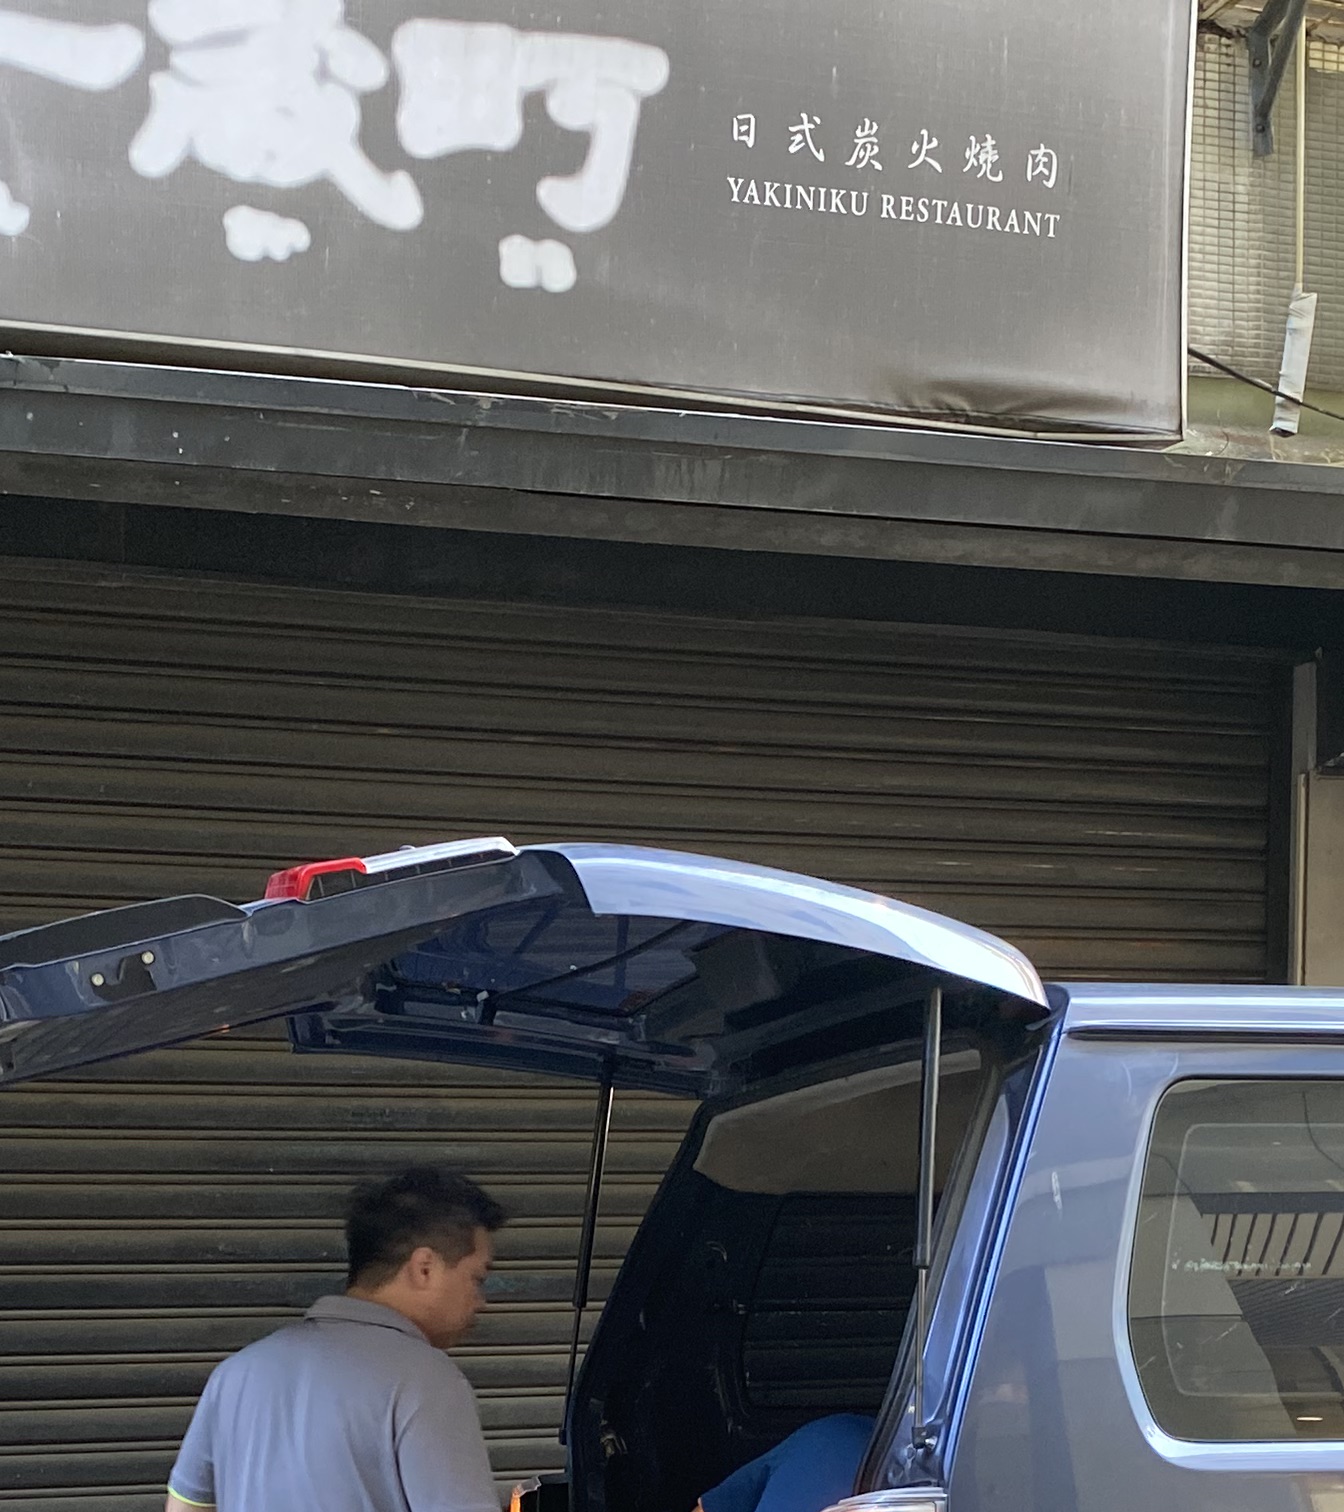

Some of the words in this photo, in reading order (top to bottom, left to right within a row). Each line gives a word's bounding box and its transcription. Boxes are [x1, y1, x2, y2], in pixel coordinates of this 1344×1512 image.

[731, 111, 1059, 189] 日式炭火燒肉
[727, 176, 870, 217] YAKINIKU
[880, 193, 1061, 239] RESTAURANT
